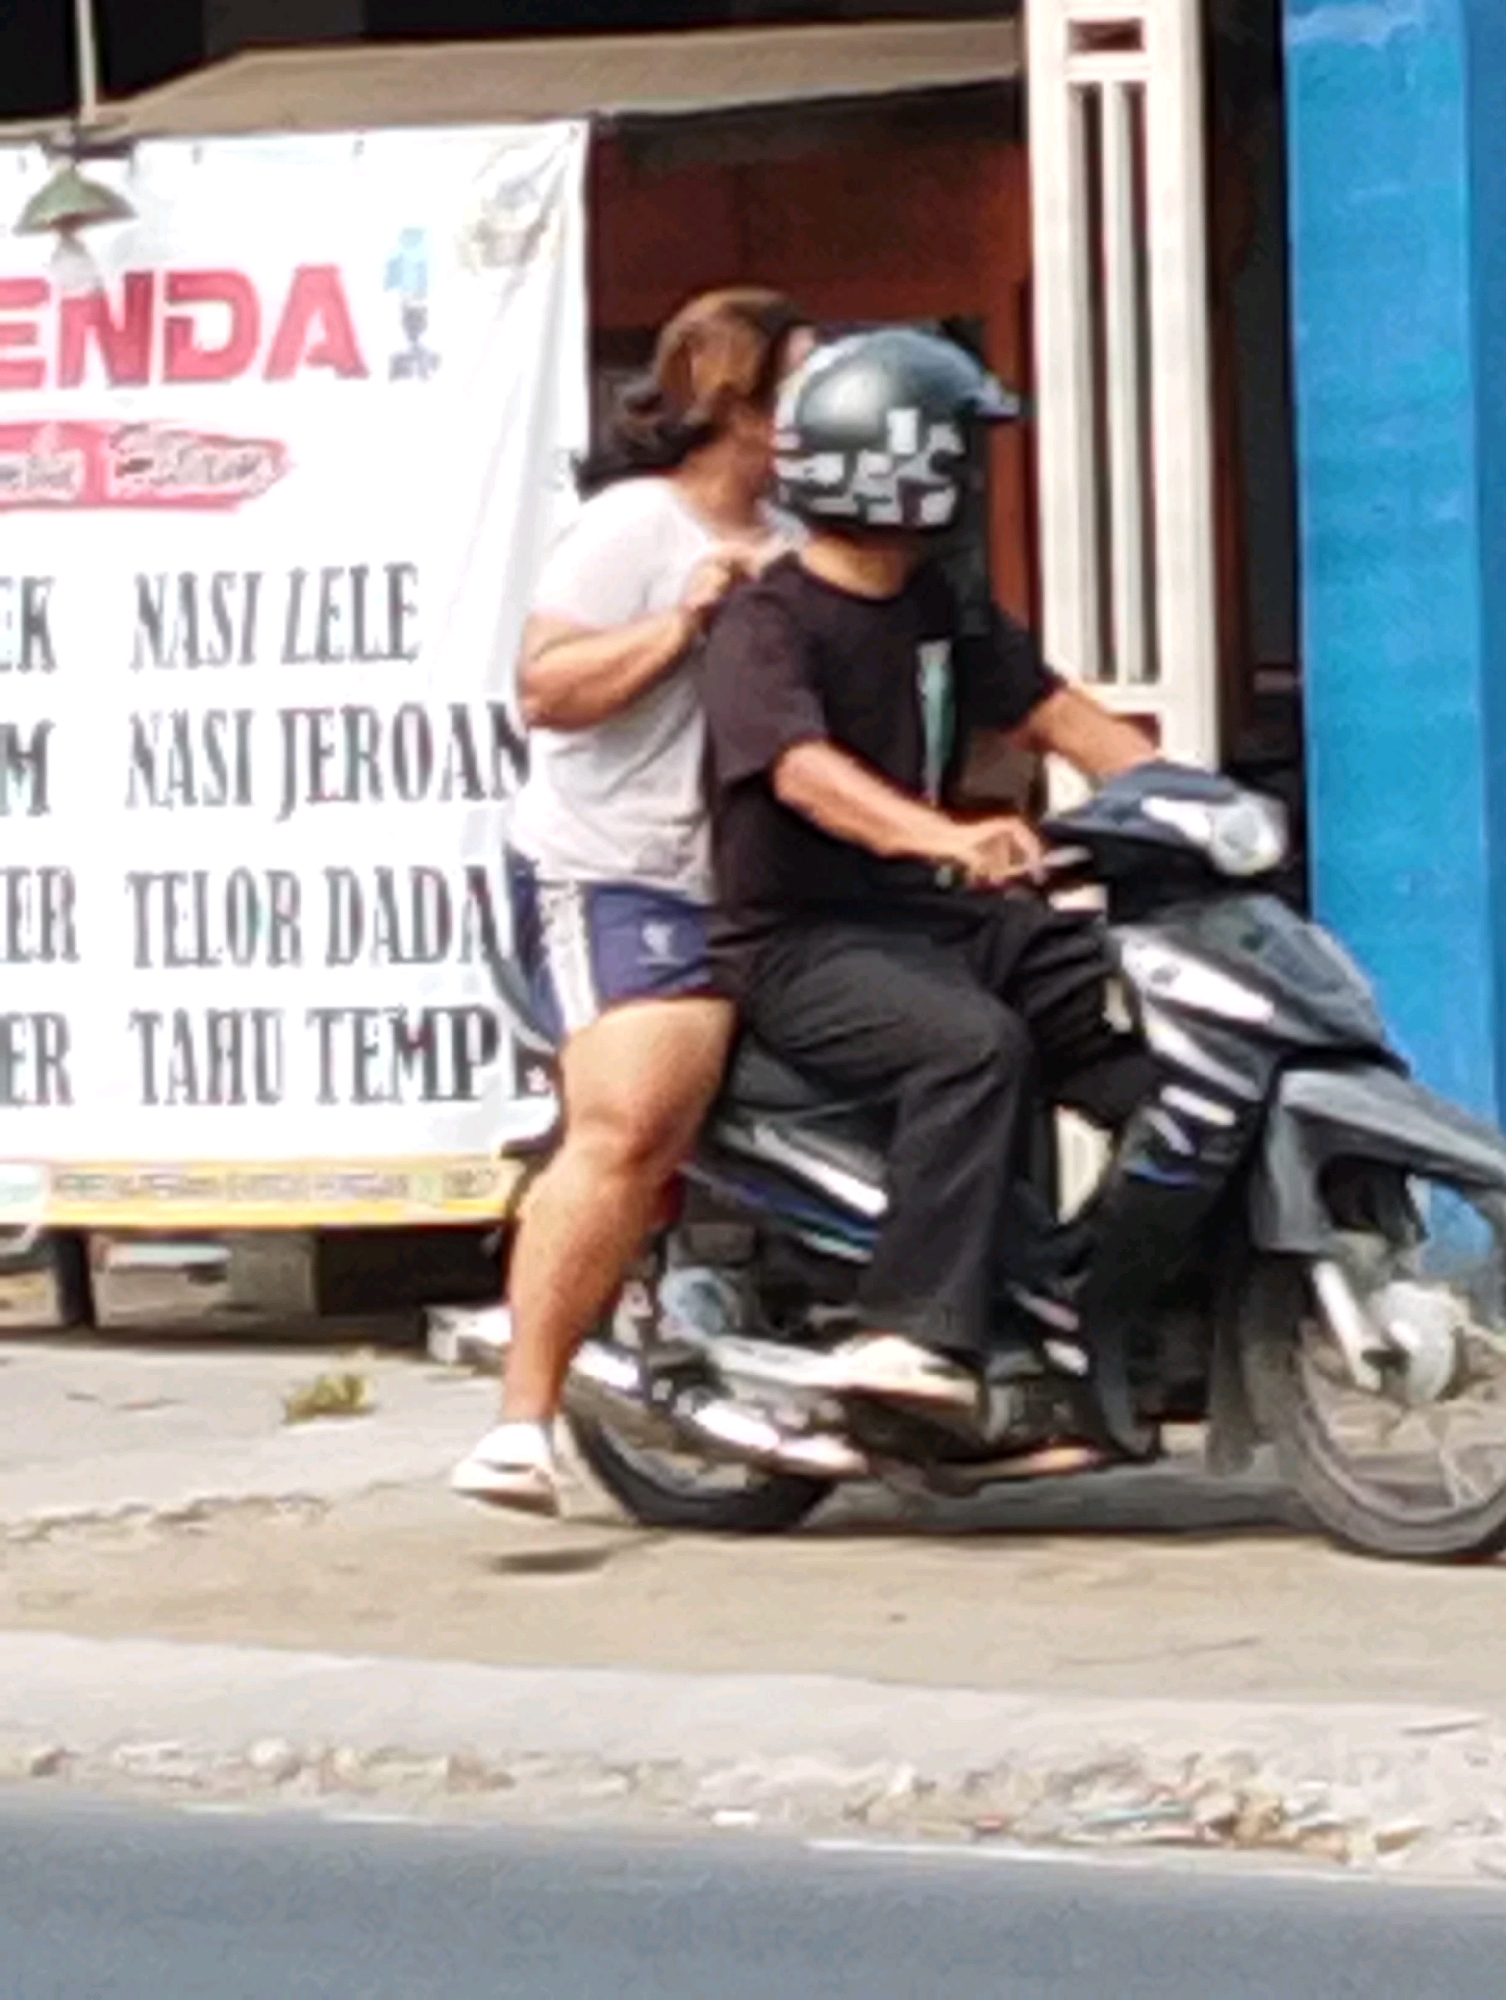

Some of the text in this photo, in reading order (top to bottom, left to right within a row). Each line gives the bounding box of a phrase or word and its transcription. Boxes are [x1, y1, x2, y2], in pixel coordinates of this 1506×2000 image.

[0, 264, 370, 391] ENDA
[131, 562, 418, 671] NASI LELE
[125, 699, 530, 822] NASI JEROAN
[125, 866, 302, 969] TELOR
[128, 1007, 283, 1107] TAHU
